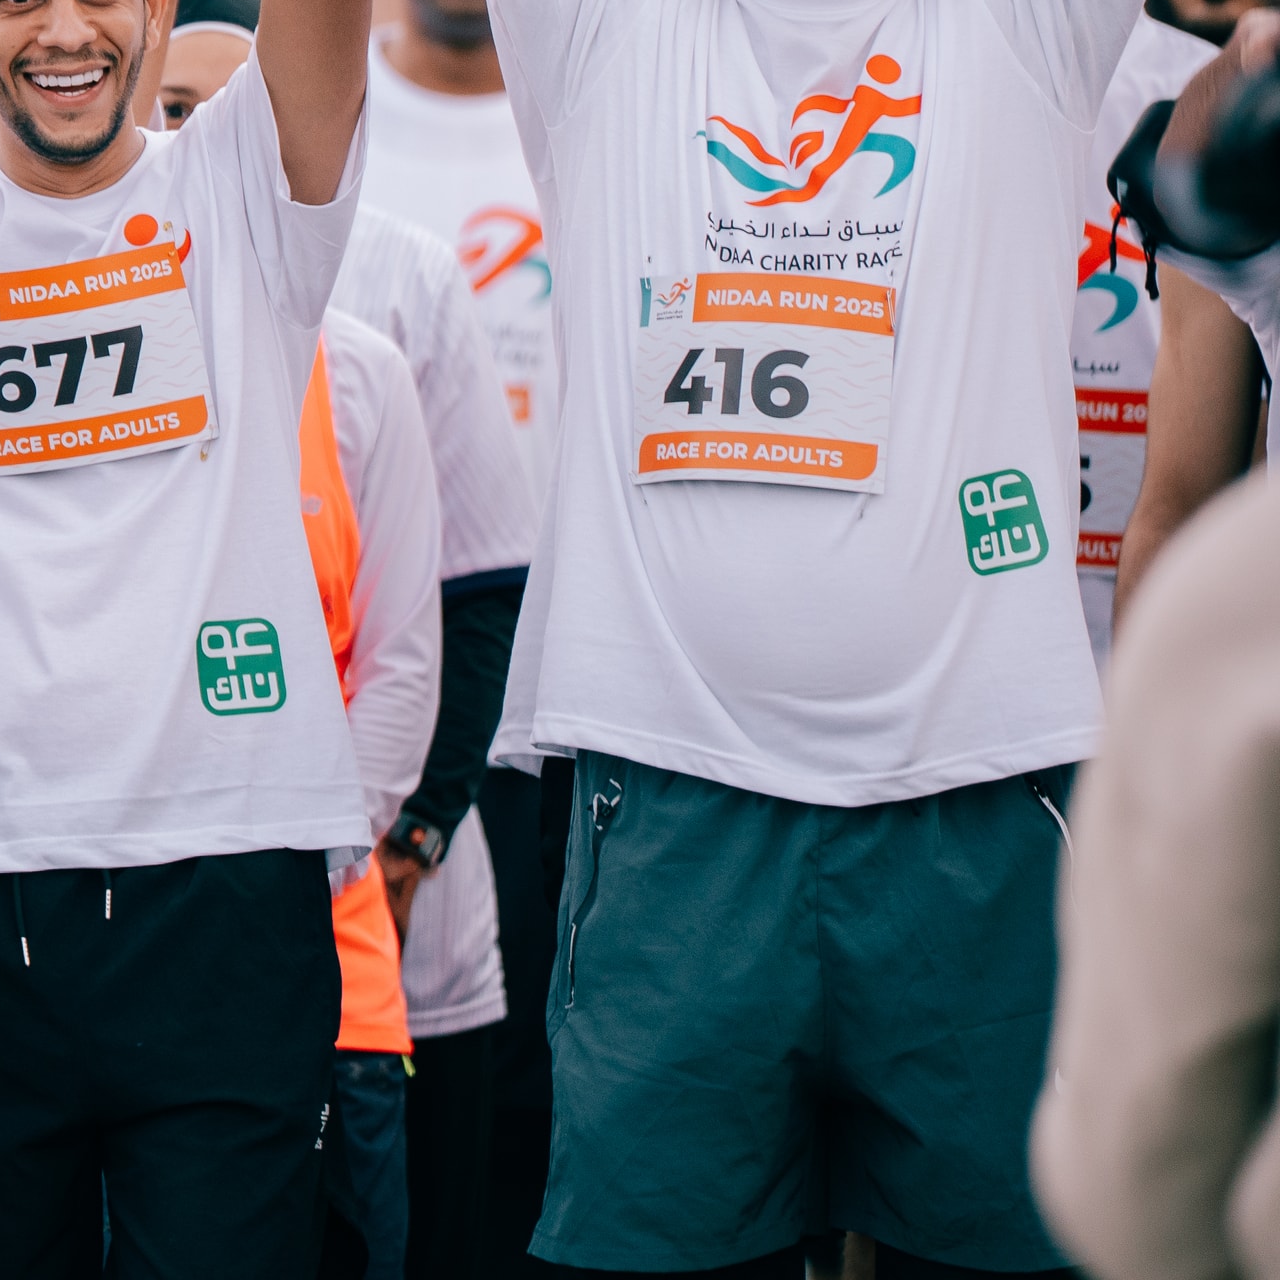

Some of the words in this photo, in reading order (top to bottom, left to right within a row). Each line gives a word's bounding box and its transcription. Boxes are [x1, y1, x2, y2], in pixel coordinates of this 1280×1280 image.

[781, 219, 831, 239] نداء
[838, 219, 904, 241] سباق
[705, 233, 754, 265] NDAA
[760, 253, 848, 271] CHARITY
[9, 280, 80, 305] NIDAA
[84, 269, 127, 293] RUN
[129, 259, 173, 283] 2025
[706, 289, 776, 308] NIDAA
[779, 292, 828, 311] RUN
[833, 296, 885, 319] 2025
[664, 347, 810, 419] 416
[48, 429, 93, 450] FOR
[98, 412, 181, 444] ADULTS
[656, 442, 700, 461] RACE
[704, 442, 748, 460] FOR
[752, 444, 844, 468] ADULTS
